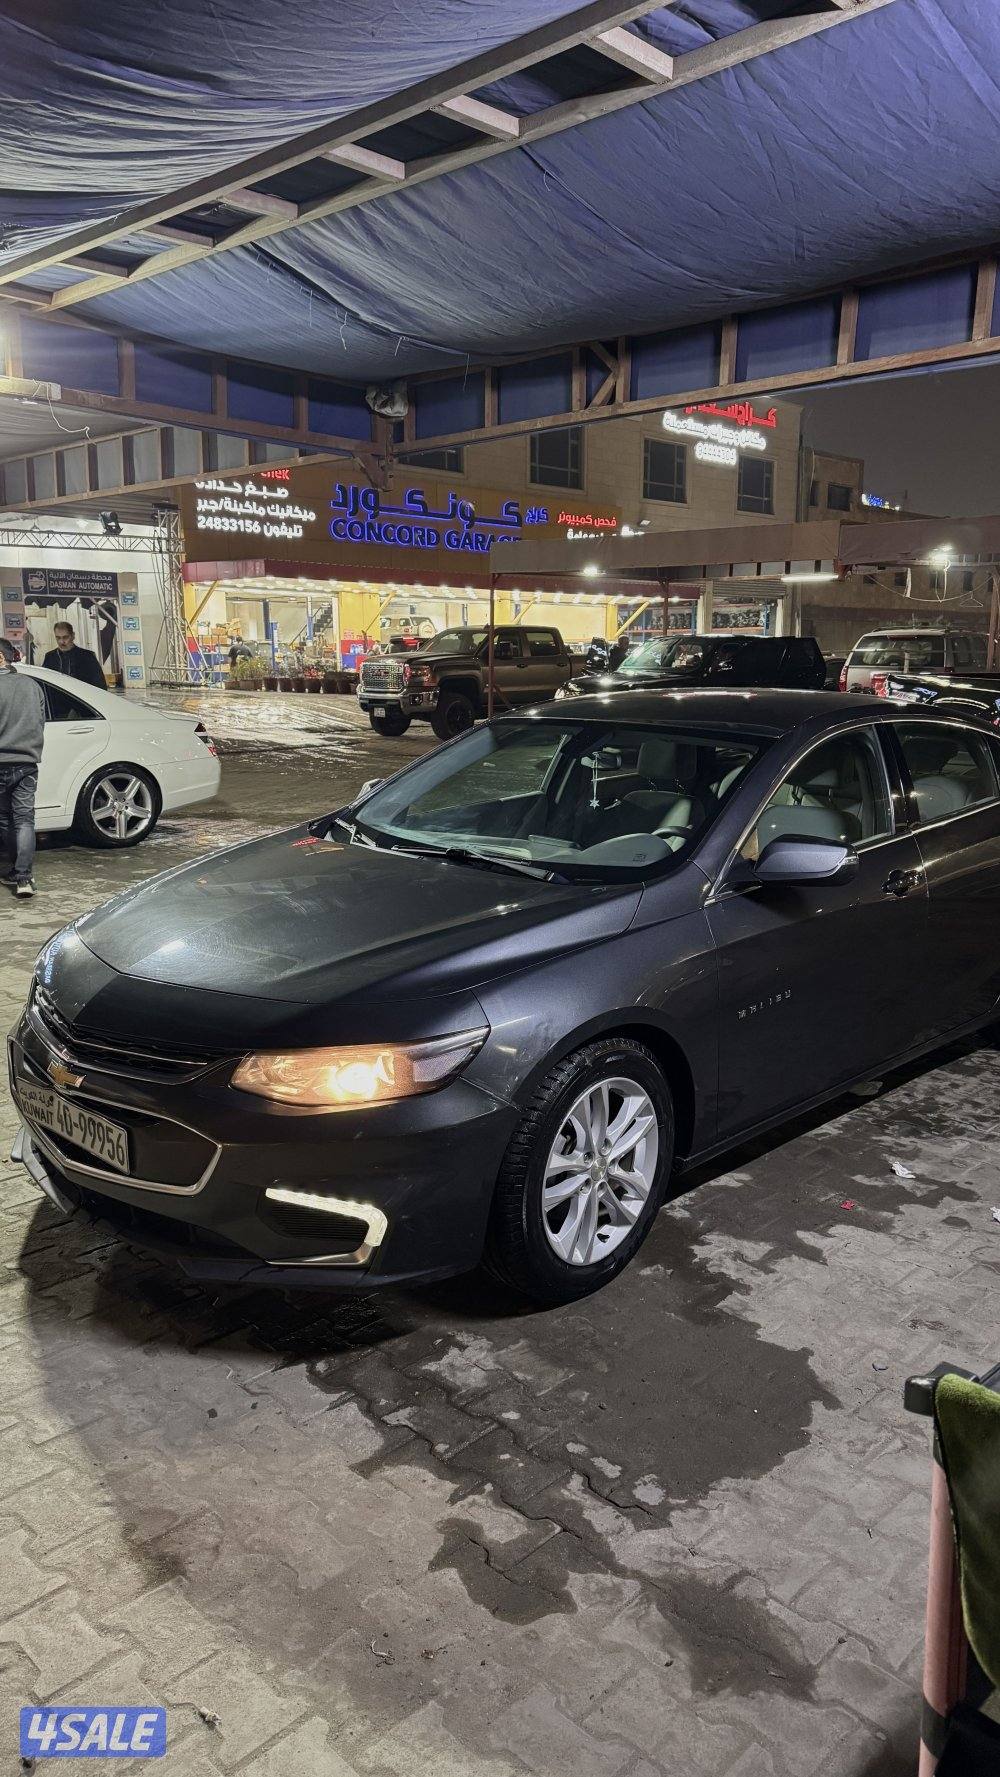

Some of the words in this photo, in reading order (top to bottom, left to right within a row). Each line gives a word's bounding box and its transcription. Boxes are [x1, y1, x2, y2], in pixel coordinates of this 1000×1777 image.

[244, 480, 289, 499] صبغ
[266, 503, 317, 522] ميكانيك
[331, 483, 522, 529] كونكورد
[197, 515, 261, 534] 24833156
[525, 507, 550, 525] كراج
[557, 511, 593, 526] كمبيوتر
[594, 516, 617, 527] فحص
[263, 521, 303, 539] تليفون
[330, 517, 440, 548] CONCORD
[49, 581, 77, 589] DASMAN
[79, 582, 113, 591] AUTOMATIC
[66, 573, 90, 581] دسمان
[22, 1098, 54, 1126] KUWAIT
[56, 1101, 125, 1167] 40-99956
